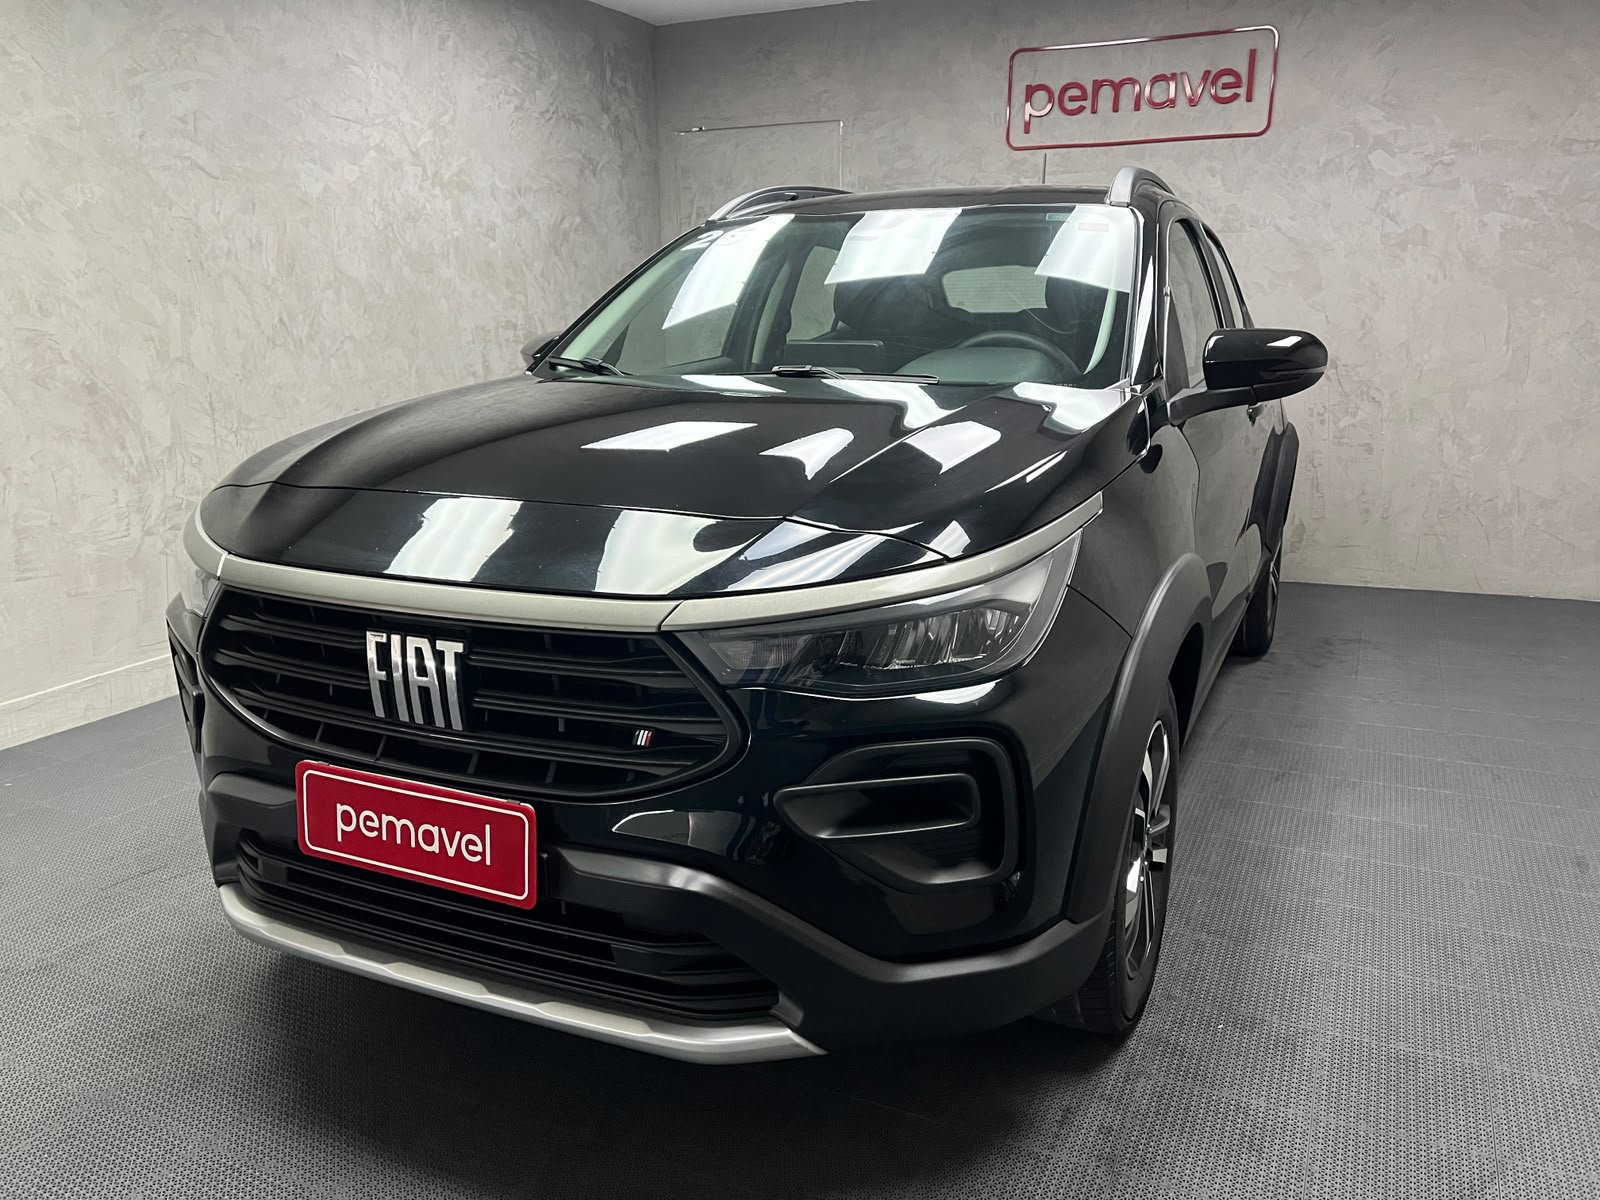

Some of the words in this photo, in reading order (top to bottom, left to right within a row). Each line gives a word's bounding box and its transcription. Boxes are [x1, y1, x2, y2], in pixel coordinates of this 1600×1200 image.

[1023, 48, 1257, 135] pemavel
[365, 630, 464, 731] FIAT
[336, 802, 491, 866] pemavel
